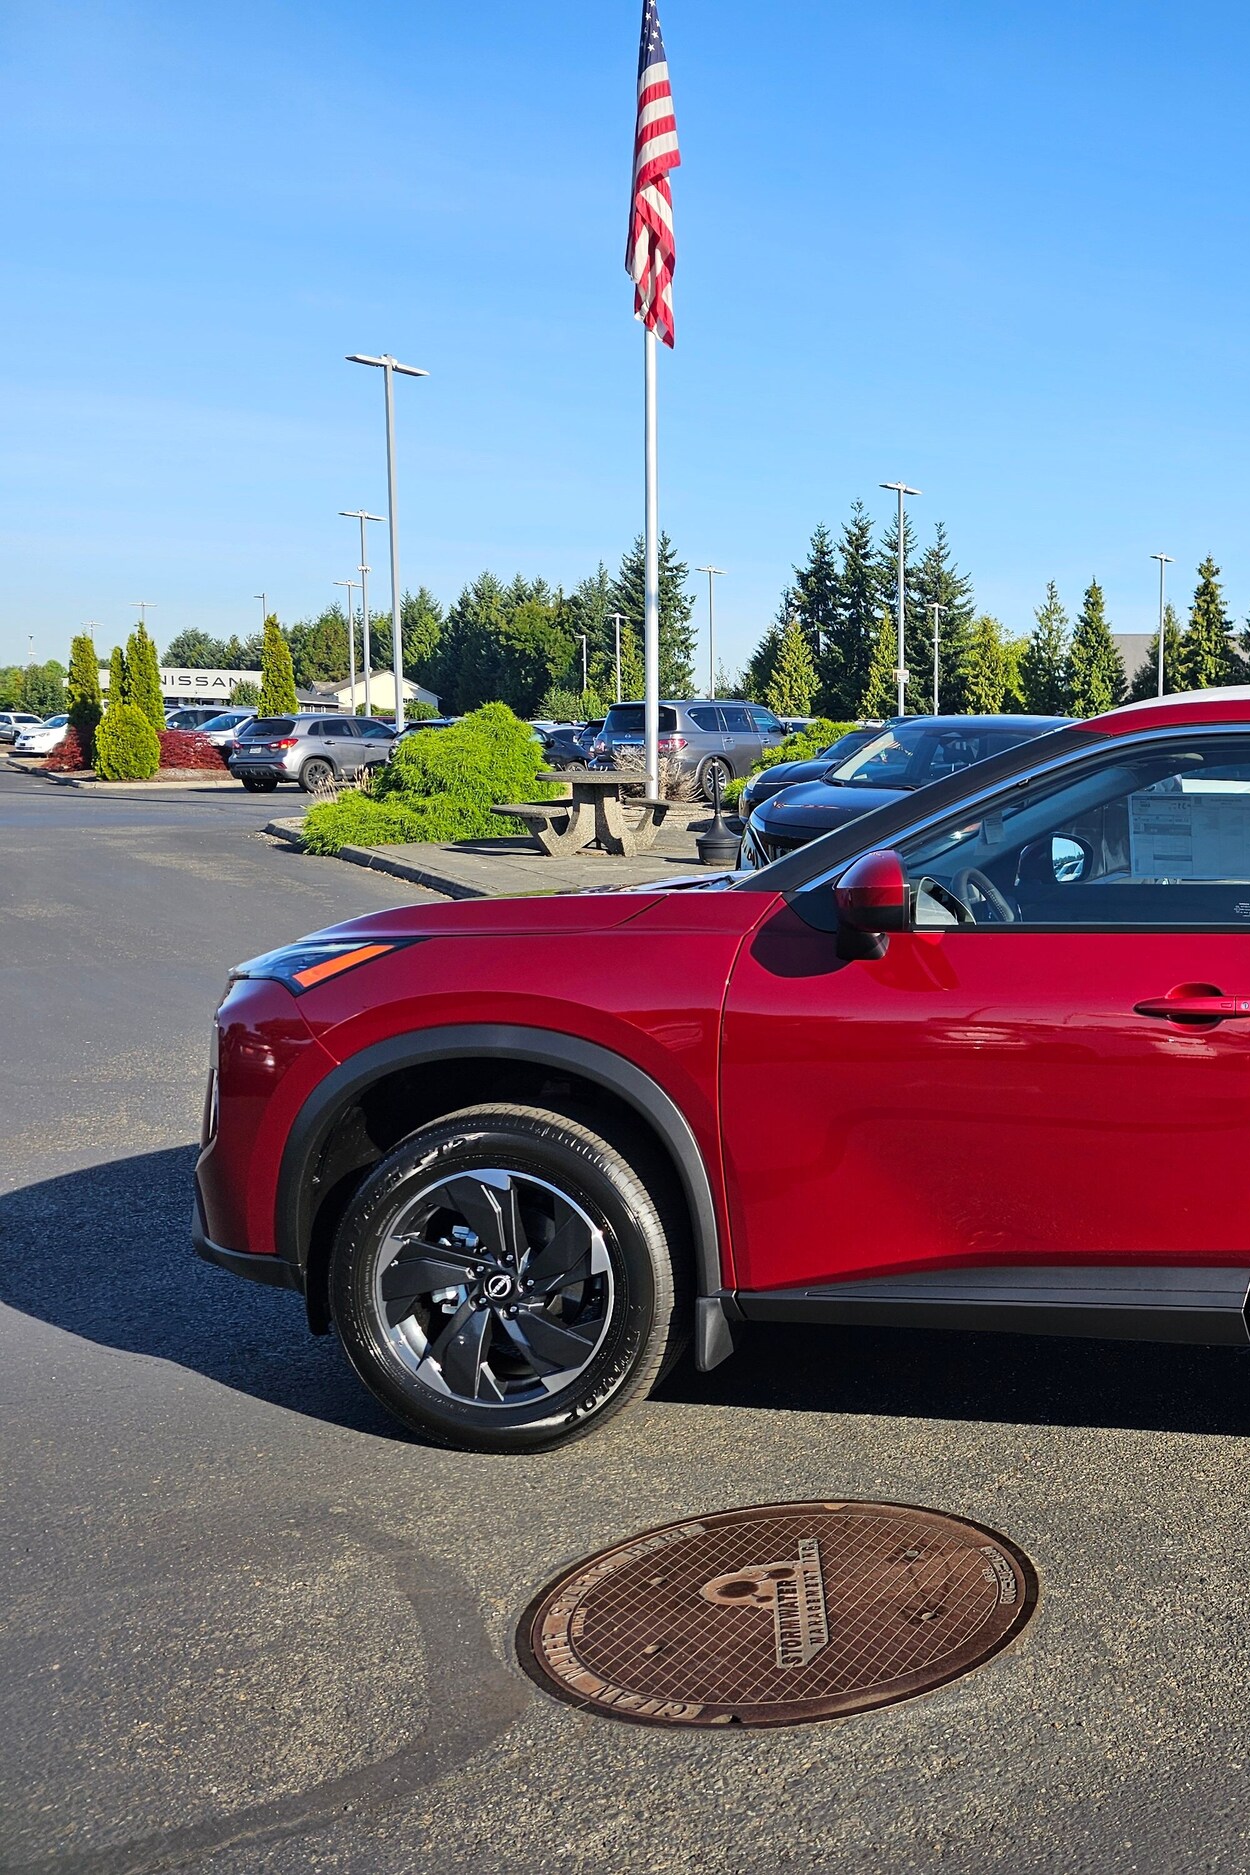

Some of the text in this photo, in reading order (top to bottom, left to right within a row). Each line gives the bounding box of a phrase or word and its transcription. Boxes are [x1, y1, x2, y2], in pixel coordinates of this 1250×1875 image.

[549, 1563, 617, 1616] STARTS
[803, 1570, 825, 1645] MANAGEMENT
[777, 1580, 803, 1664] STORMWATER
[542, 1632, 590, 1683] WATER
[588, 1684, 688, 1718] CLEAN
